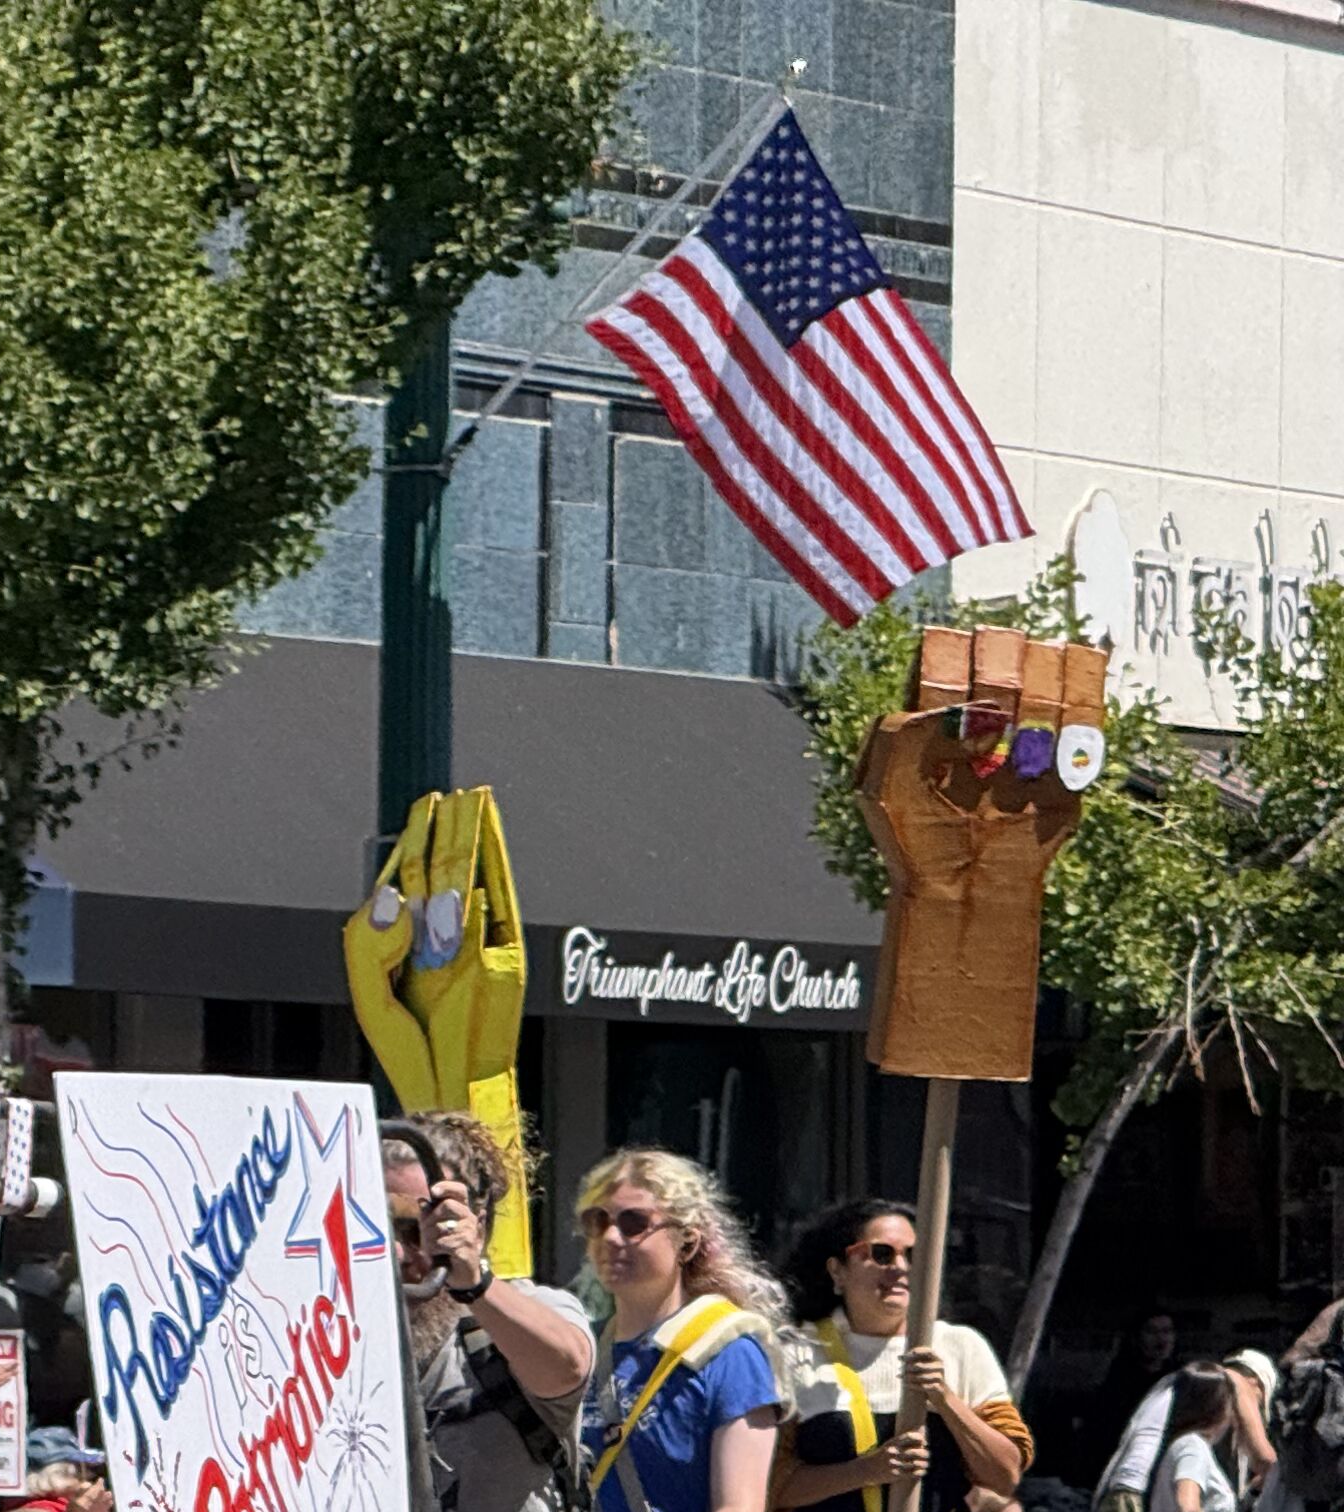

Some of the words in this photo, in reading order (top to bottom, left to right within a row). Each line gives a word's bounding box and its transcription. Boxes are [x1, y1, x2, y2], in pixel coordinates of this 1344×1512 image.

[563, 926, 716, 1016] Triumphant
[715, 940, 766, 1024] Life
[769, 944, 860, 1014] Church
[99, 1105, 292, 1483] Resistance
[217, 1301, 278, 1425] is
